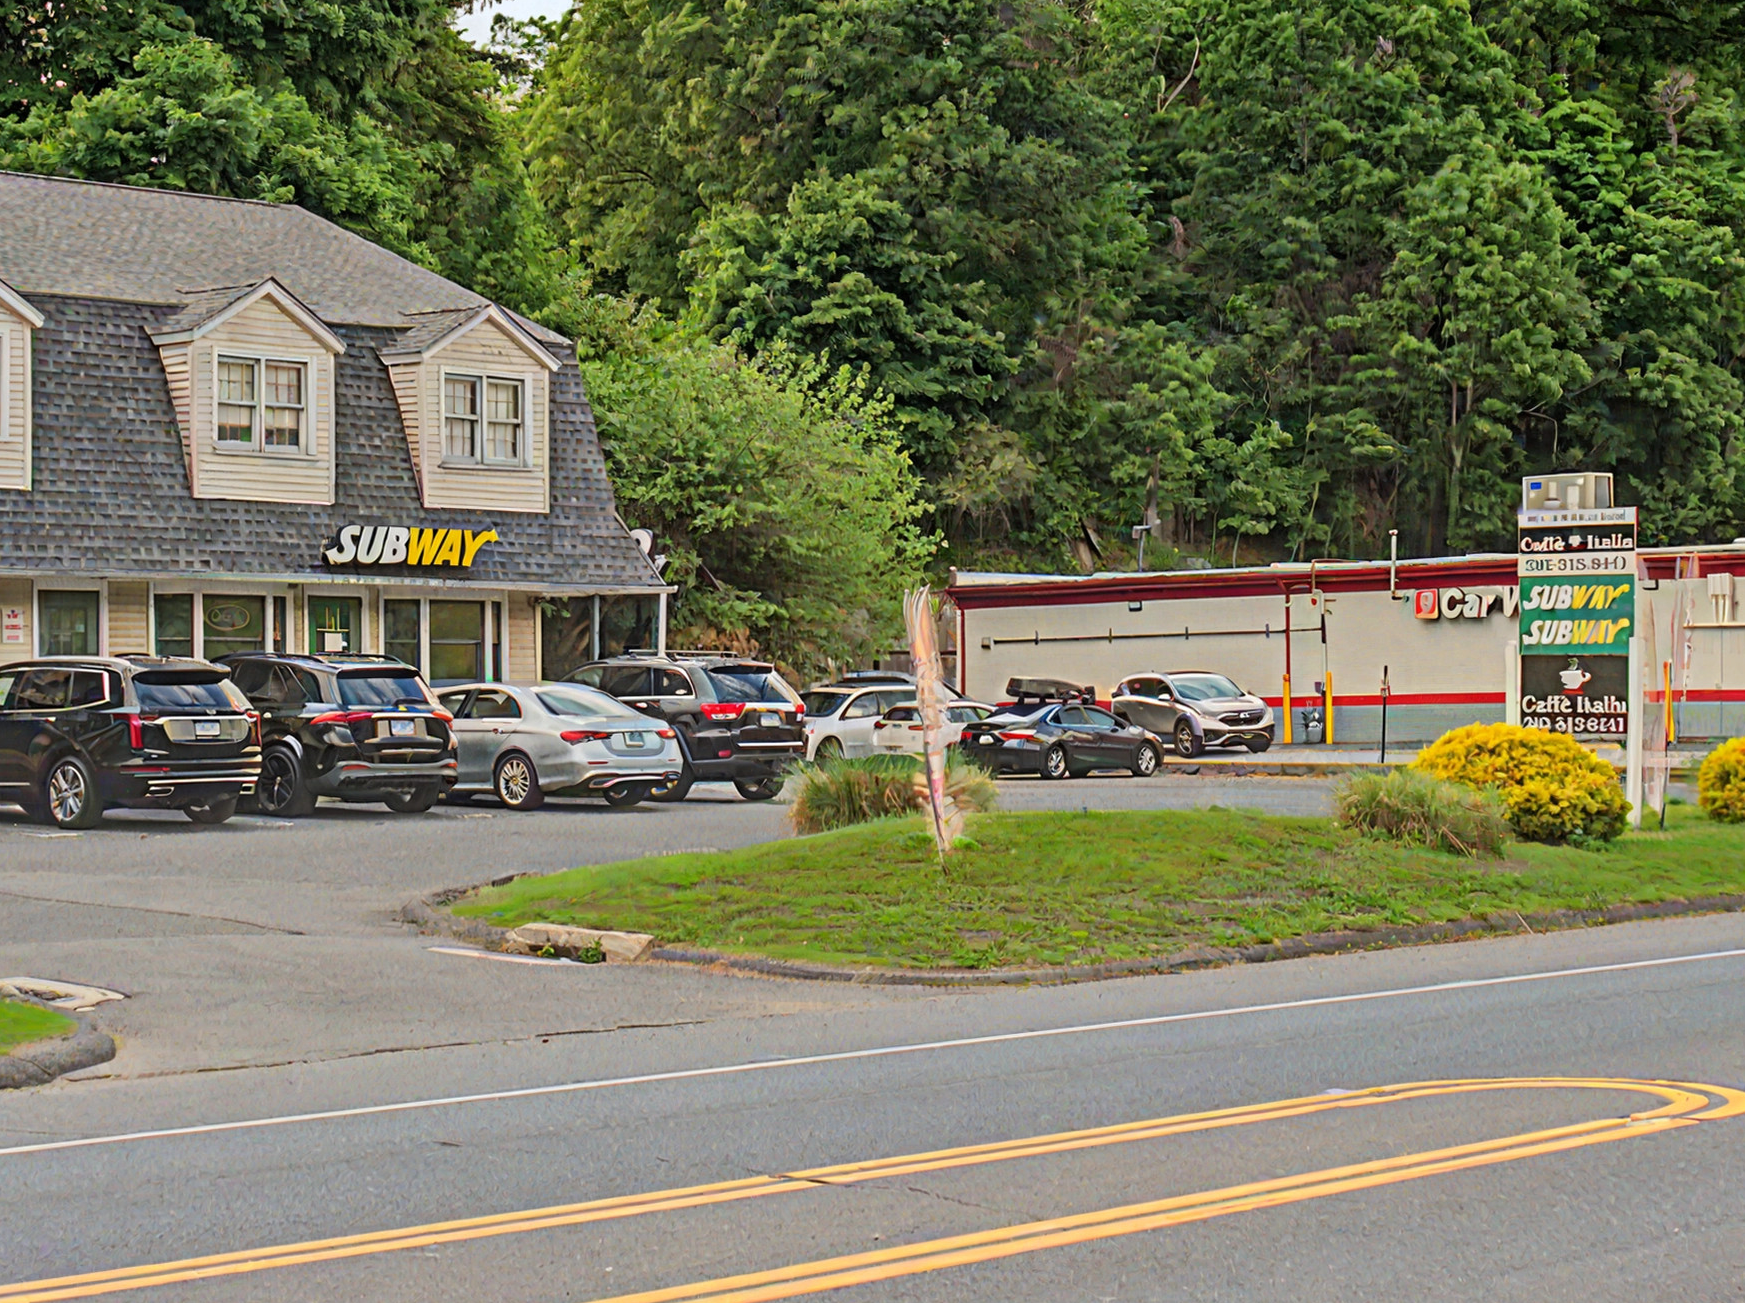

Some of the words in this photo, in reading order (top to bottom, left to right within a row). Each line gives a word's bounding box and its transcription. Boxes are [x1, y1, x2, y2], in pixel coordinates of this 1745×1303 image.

[324, 524, 500, 567] SUBWAY
[1440, 587, 1496, 619] Car
[1522, 583, 1631, 610] SUBWAY
[1522, 618, 1631, 645] SUBWAY
